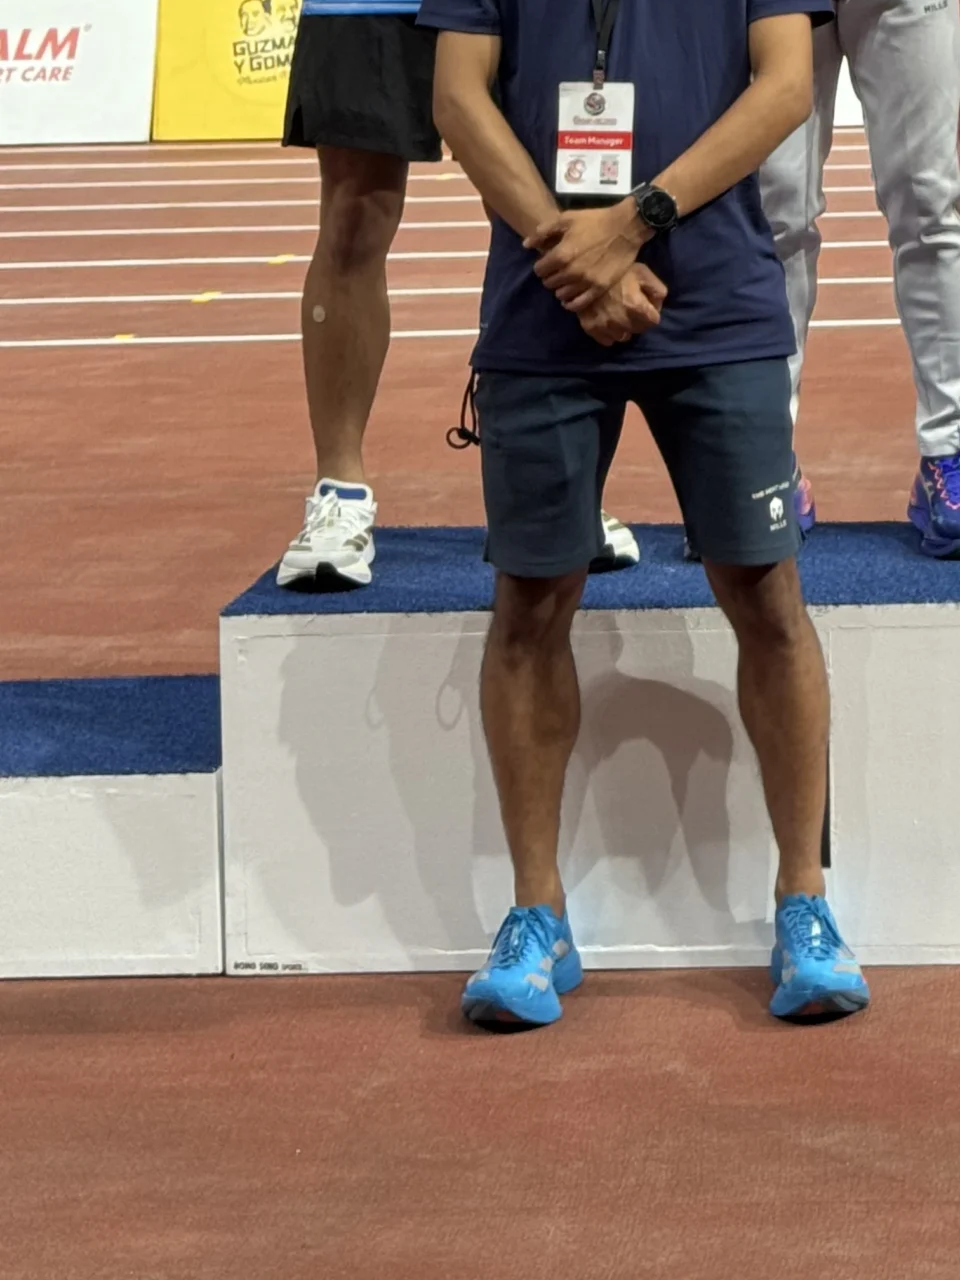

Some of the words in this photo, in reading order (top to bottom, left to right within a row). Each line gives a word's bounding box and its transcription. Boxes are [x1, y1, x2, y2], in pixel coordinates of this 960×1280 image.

[21, 65, 75, 82] CARE
[233, 59, 245, 74] Y
[563, 135, 587, 145] Team
[588, 136, 625, 147] Manager
